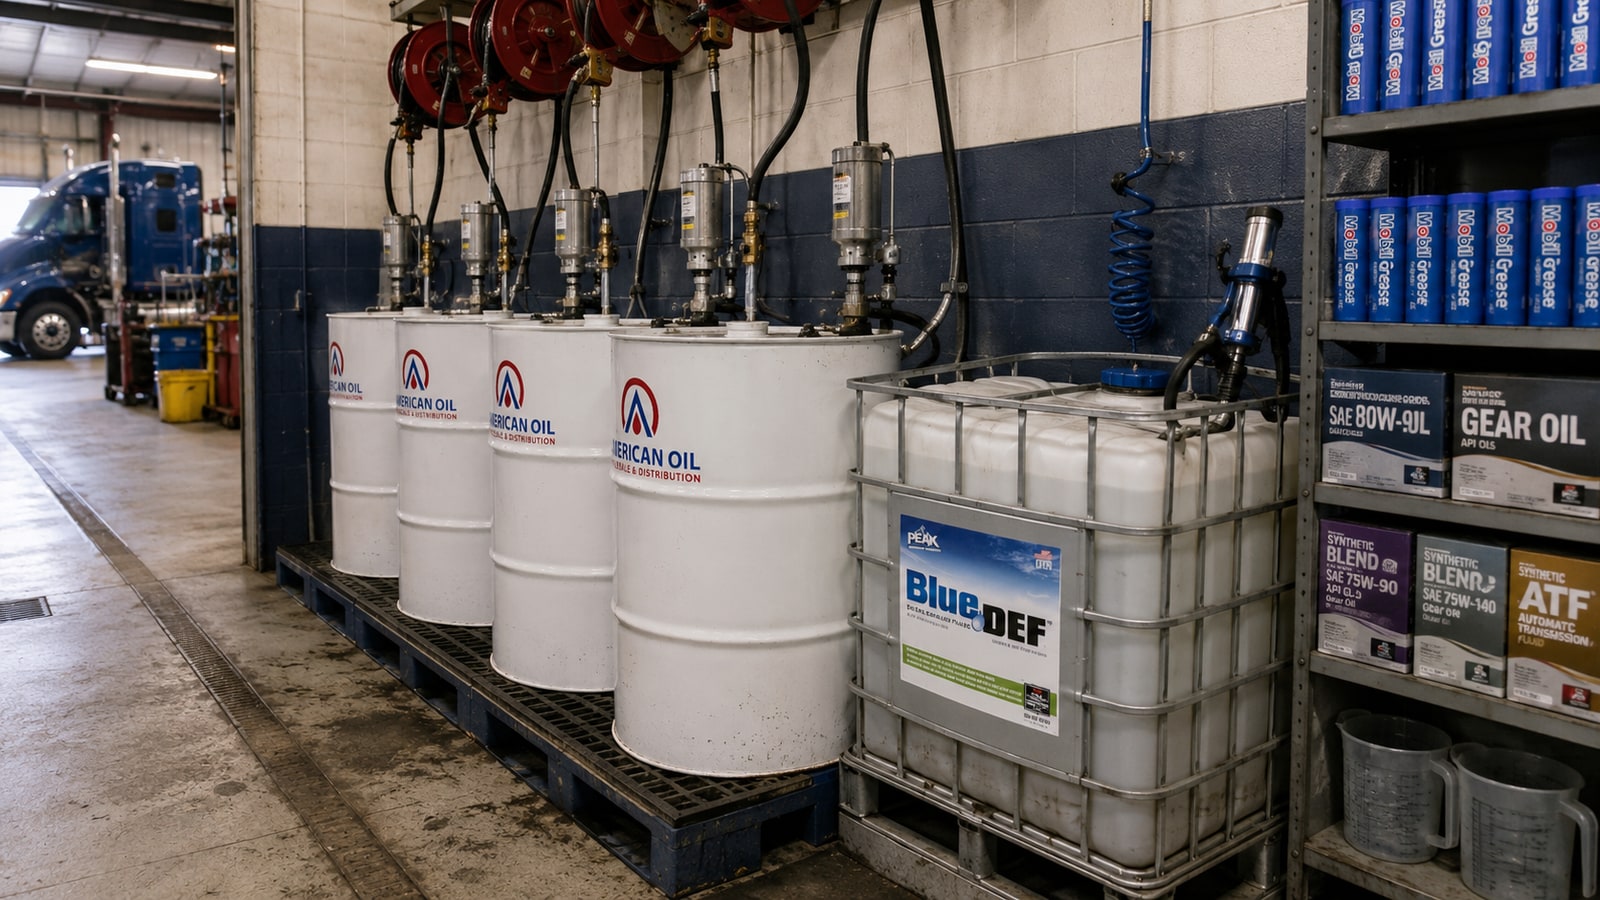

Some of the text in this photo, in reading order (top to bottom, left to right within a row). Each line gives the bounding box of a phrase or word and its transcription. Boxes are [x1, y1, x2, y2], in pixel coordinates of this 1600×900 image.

[1344, 215, 1358, 260] Mobil
[1379, 213, 1394, 259] Mobil
[1416, 211, 1432, 258] Mobil
[1458, 209, 1475, 257] Mobil
[1496, 207, 1514, 257] Mobil
[1541, 205, 1561, 256] Mobil
[347, 382, 363, 394] OIL
[435, 398, 457, 411] OIL
[1329, 404, 1354, 427] SAE
[508, 433, 556, 445] DISTRIBUTION
[530, 419, 555, 435] OIL
[1461, 406, 1587, 446] GEAR OIL
[1461, 438, 1476, 448] API
[668, 450, 701, 470] OIL
[638, 467, 701, 483] DISTRIBUTION
[907, 531, 940, 549] PEAK
[1327, 534, 1375, 551] SYNTHETIC
[1326, 545, 1380, 571] BLEND
[1326, 569, 1398, 596] SAE 75W-90
[906, 568, 980, 620] Blue
[982, 603, 1047, 648] DEF
[1422, 587, 1496, 614] SAE 75W-140
[1518, 580, 1592, 620] ATF
